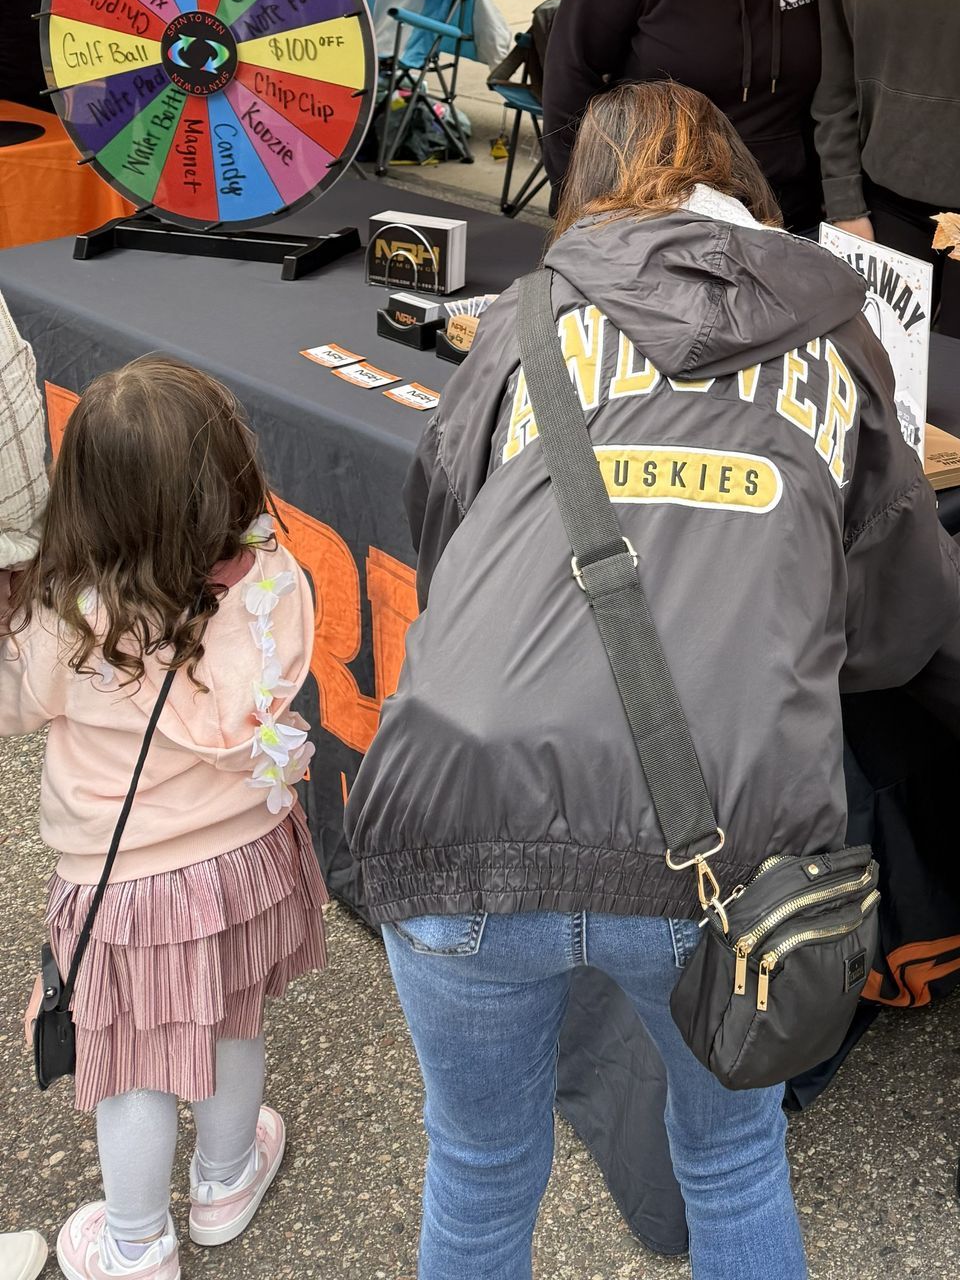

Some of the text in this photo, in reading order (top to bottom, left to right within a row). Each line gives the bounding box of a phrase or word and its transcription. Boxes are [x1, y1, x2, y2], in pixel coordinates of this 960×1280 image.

[105, 0, 150, 35] Chip
[167, 13, 226, 37] SPIN TO WIN
[244, 3, 285, 37] Note
[62, 32, 149, 69] Golf Ball
[268, 36, 345, 62] $100 OFF
[132, 67, 167, 98] Pad
[171, 71, 230, 94] SPIN TO WIN
[254, 71, 335, 123] Chip Clip
[122, 131, 161, 176] Water
[176, 119, 204, 194] Magnet
[213, 123, 247, 197] Candy
[374, 238, 440, 273] NRH
[845, 252, 926, 332] EAWAY
[395, 311, 417, 325] NRH
[451, 322, 468, 335] NRH
[323, 350, 348, 362] NRH
[355, 369, 383, 383] NRH
[406, 390, 436, 404] NRH
[501, 304, 858, 489] ANDER
[597, 460, 760, 497] USKIES
